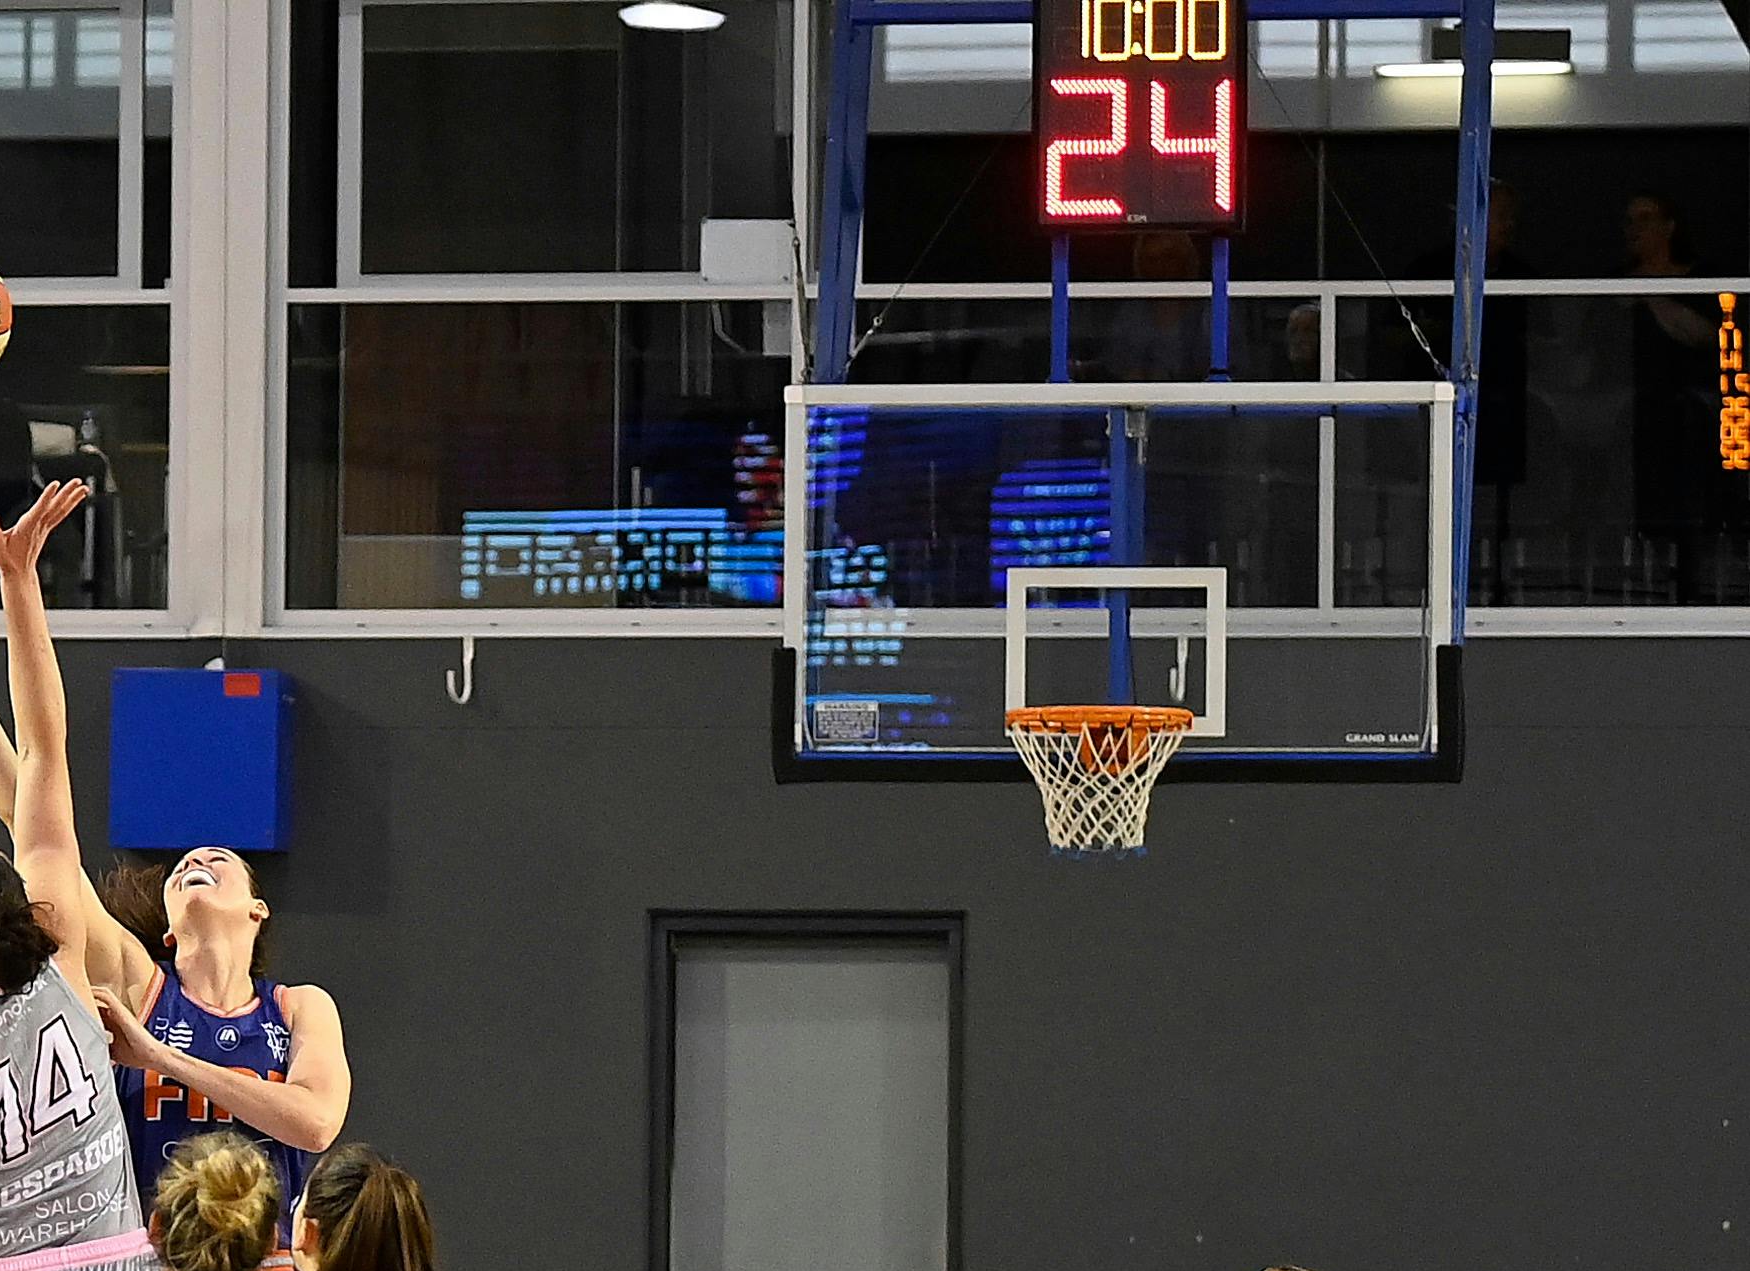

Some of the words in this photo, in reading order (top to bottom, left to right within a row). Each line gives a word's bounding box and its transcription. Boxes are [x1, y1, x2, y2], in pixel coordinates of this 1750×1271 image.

[1081, 0, 1227, 61] 10:00
[1046, 78, 1231, 216] 24
[35, 1188, 111, 1219] SALON
